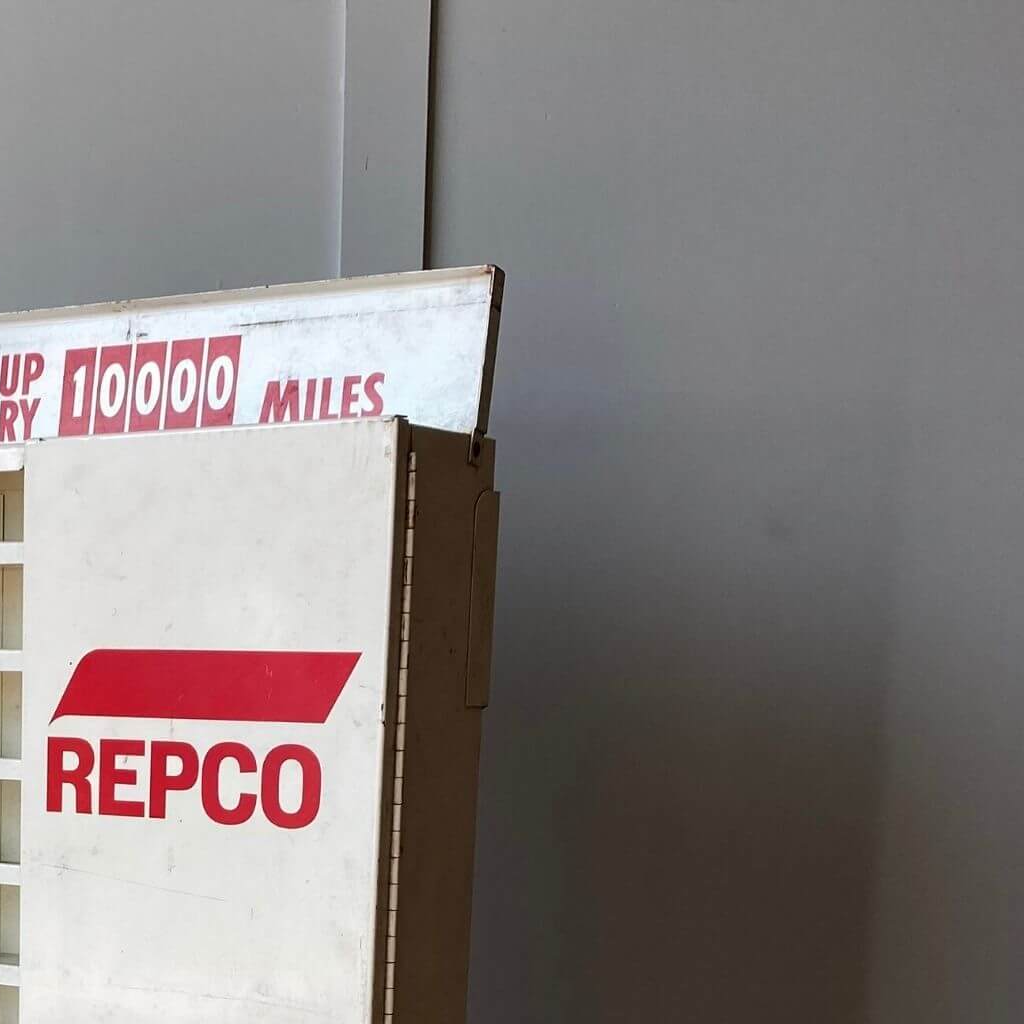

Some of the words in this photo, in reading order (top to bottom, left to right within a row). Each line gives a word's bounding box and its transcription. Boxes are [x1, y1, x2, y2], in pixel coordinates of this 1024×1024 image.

[0, 352, 45, 397] UP
[67, 353, 236, 421] 10000
[259, 372, 385, 424] MILES
[46, 736, 322, 830] REPCO
